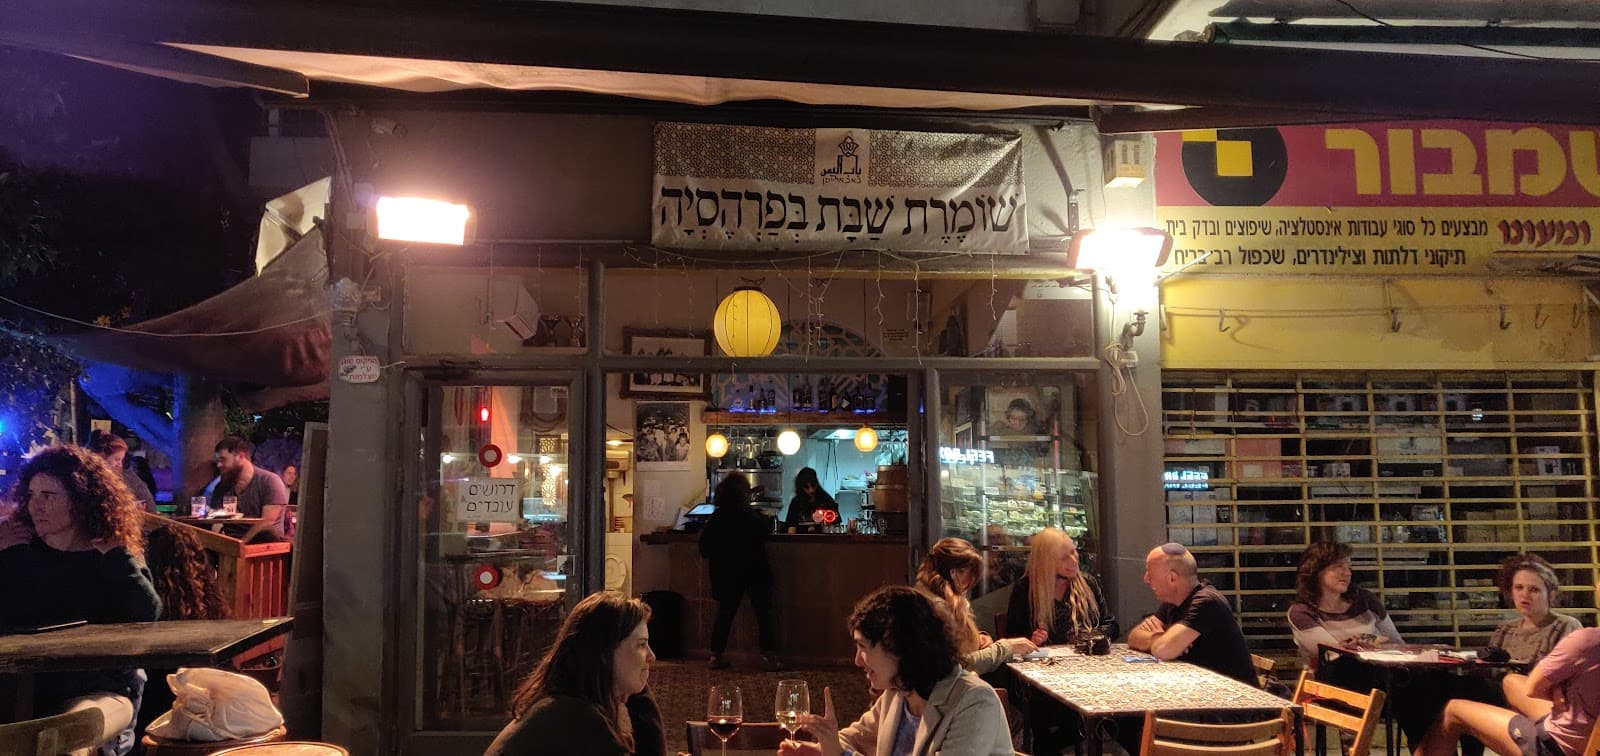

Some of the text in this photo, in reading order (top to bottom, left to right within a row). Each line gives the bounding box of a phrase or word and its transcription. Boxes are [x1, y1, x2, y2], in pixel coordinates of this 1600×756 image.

[1166, 216, 1488, 240] מבצעים כל סוגי עבודות אינסטלציה, שיפוצים ובדק בית
[1238, 245, 1285, 265] שכפול
[1292, 245, 1366, 266] וצילינדרים,
[1373, 245, 1418, 265] דלתות
[1424, 249, 1466, 268] תיקוני
[469, 483, 516, 496] דרושים
[466, 500, 513, 512] עובדים
